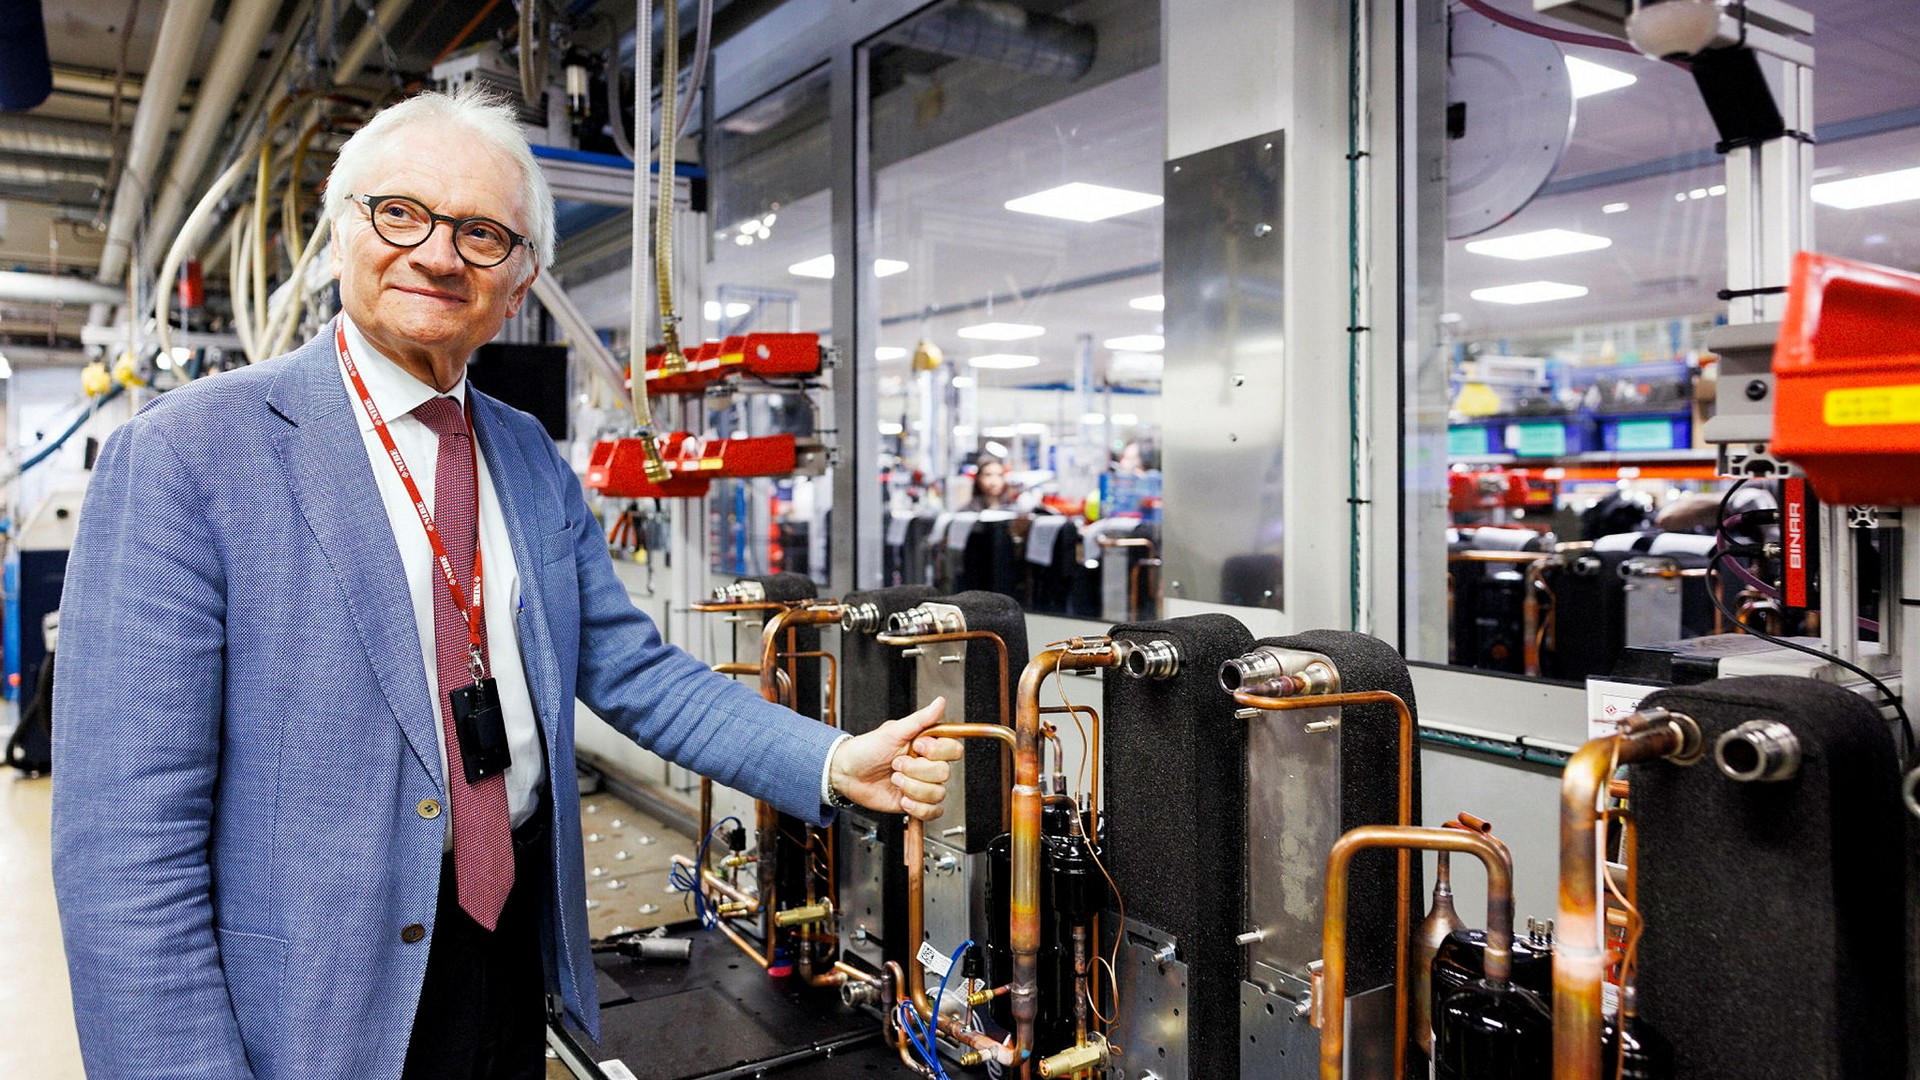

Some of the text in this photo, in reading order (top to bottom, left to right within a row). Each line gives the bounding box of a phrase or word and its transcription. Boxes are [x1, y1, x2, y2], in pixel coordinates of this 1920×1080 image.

[363, 397, 380, 420] NIBE
[389, 448, 407, 472] NIBE
[416, 501, 432, 525] NIBE
[1789, 503, 1801, 569] BINAR
[440, 554, 455, 579] NIBE
[473, 583, 481, 607] NIBE
